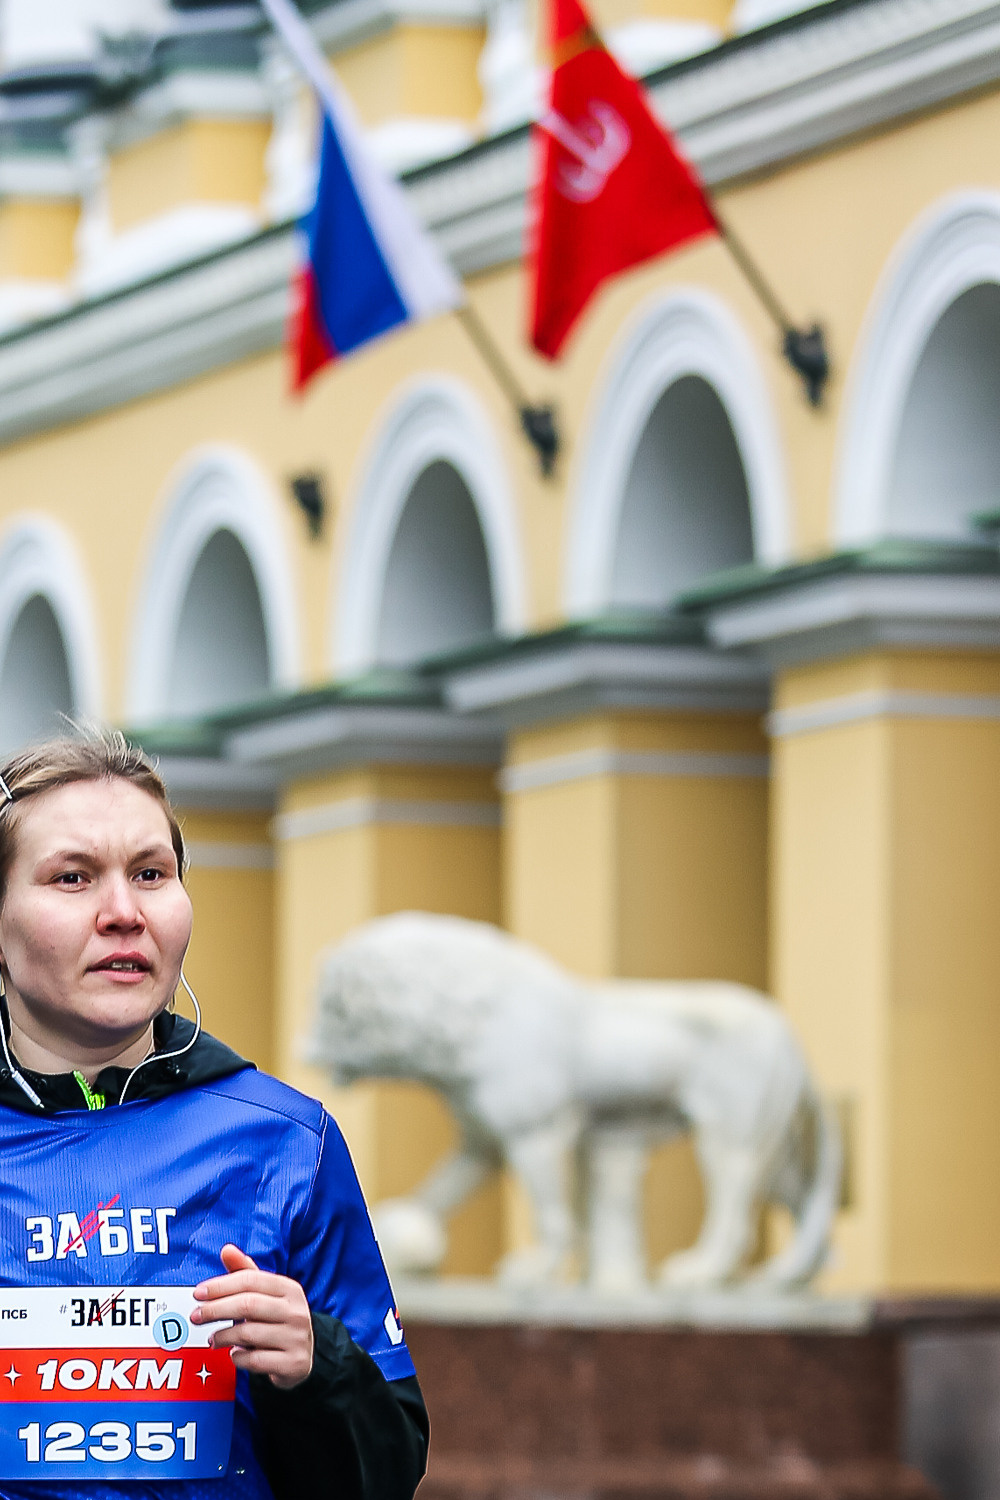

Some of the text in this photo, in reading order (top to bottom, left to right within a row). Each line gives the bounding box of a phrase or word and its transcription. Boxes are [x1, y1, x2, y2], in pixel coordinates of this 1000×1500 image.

[1, 1309, 28, 1320] ПСБ
[161, 1318, 182, 1344] D
[17, 1420, 198, 1463] 12351
